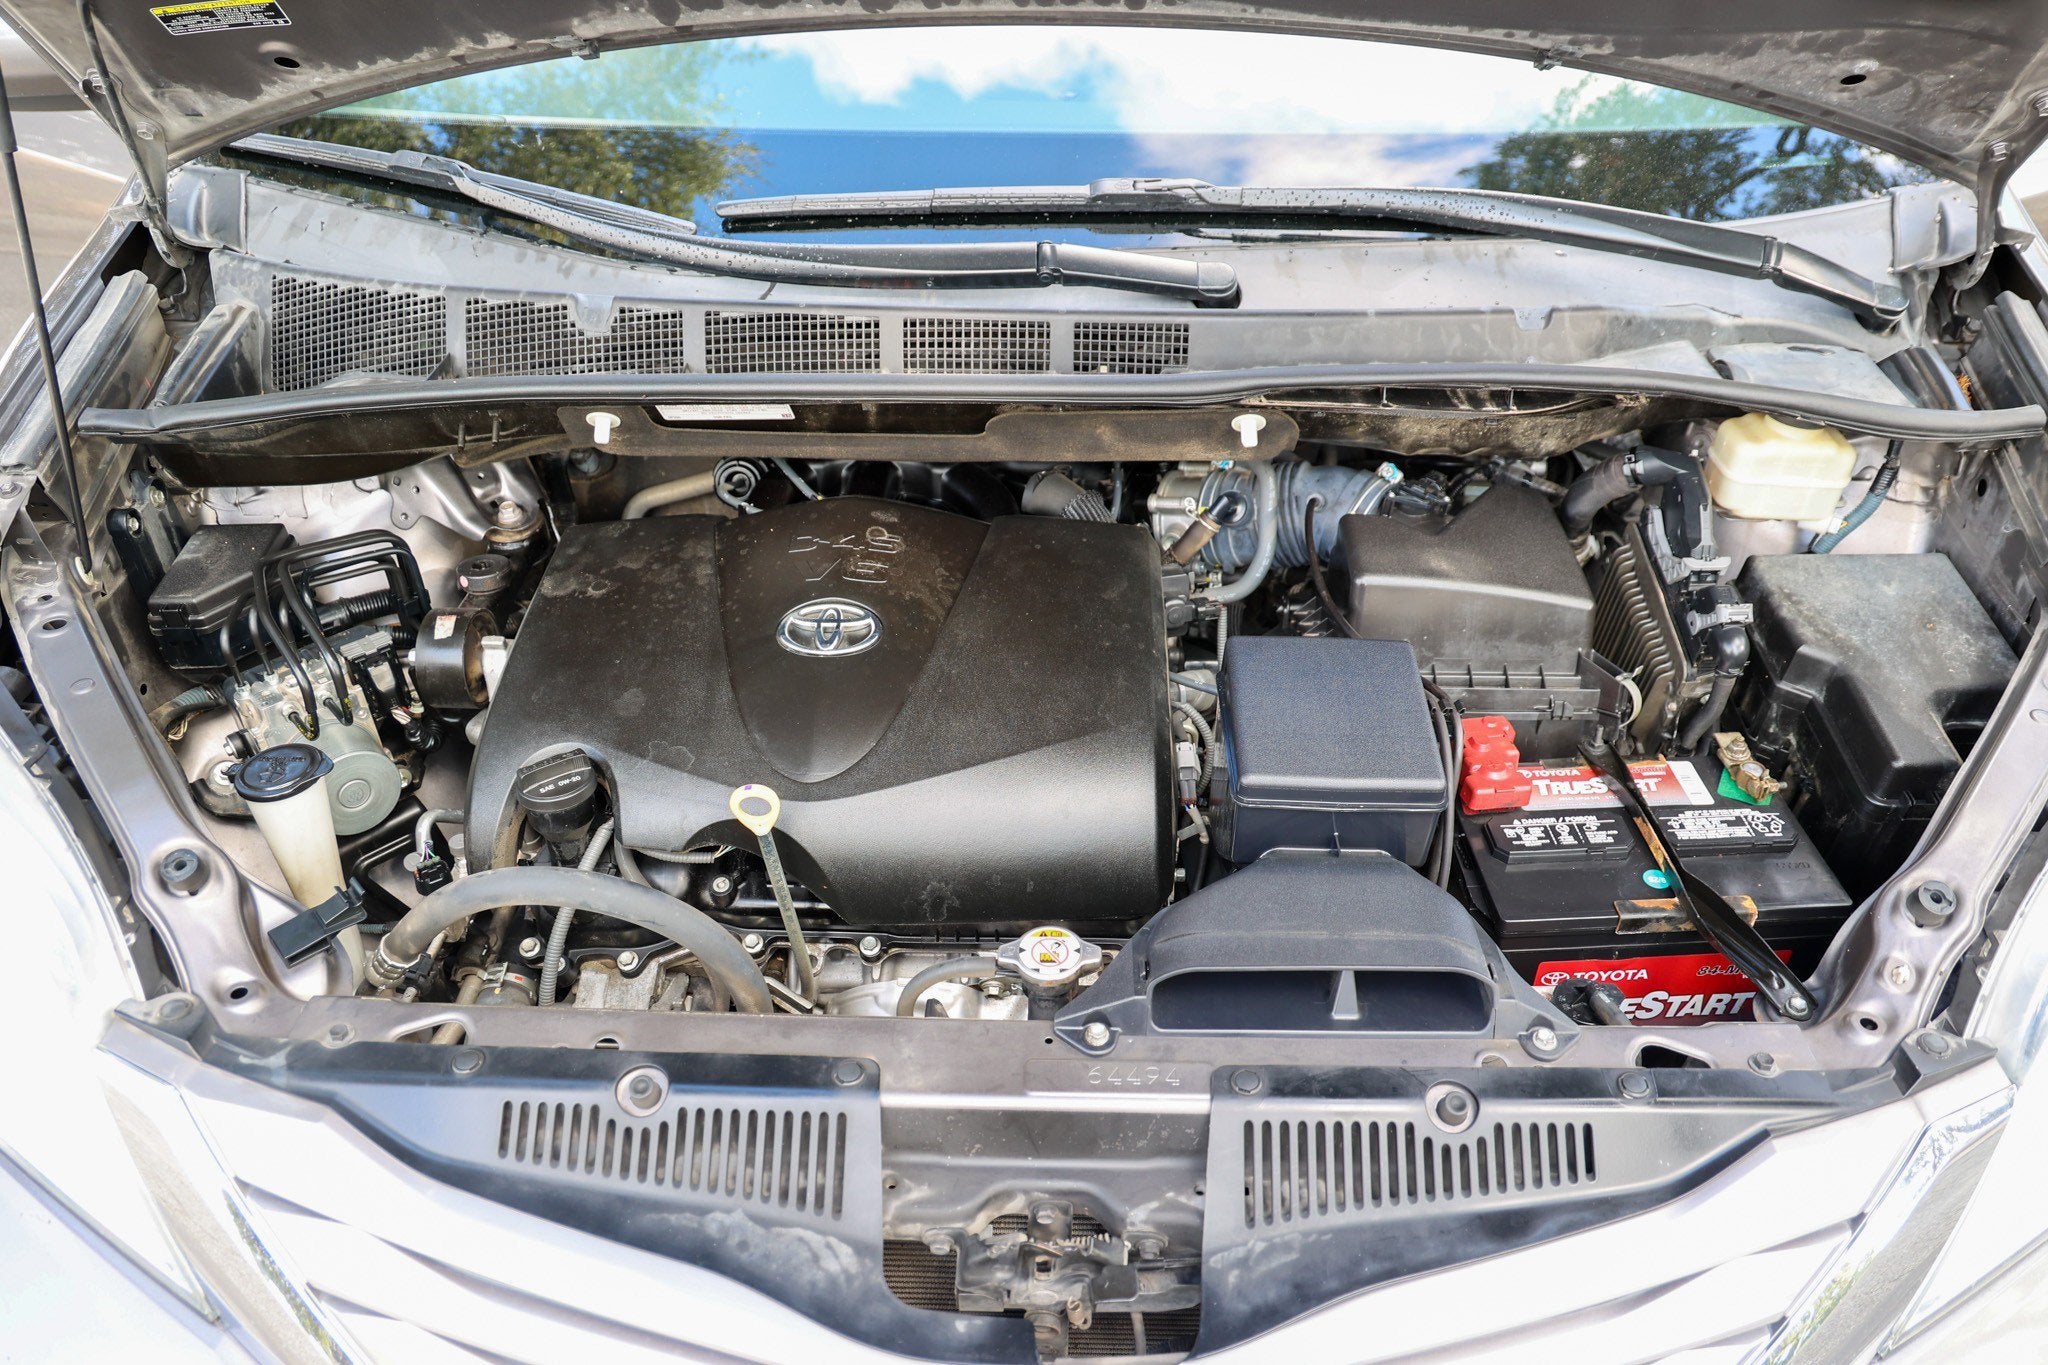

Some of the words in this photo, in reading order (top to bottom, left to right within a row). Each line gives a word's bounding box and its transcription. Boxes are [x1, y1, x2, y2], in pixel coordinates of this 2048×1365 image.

[1532, 769, 1581, 777] TOYOTA
[539, 784, 555, 794] SAE
[558, 775, 581, 787] 0W-20
[1573, 968, 1648, 982] TOYOTA
[1696, 965, 1746, 977] 84-M
[1088, 1066, 1180, 1086] 64494
